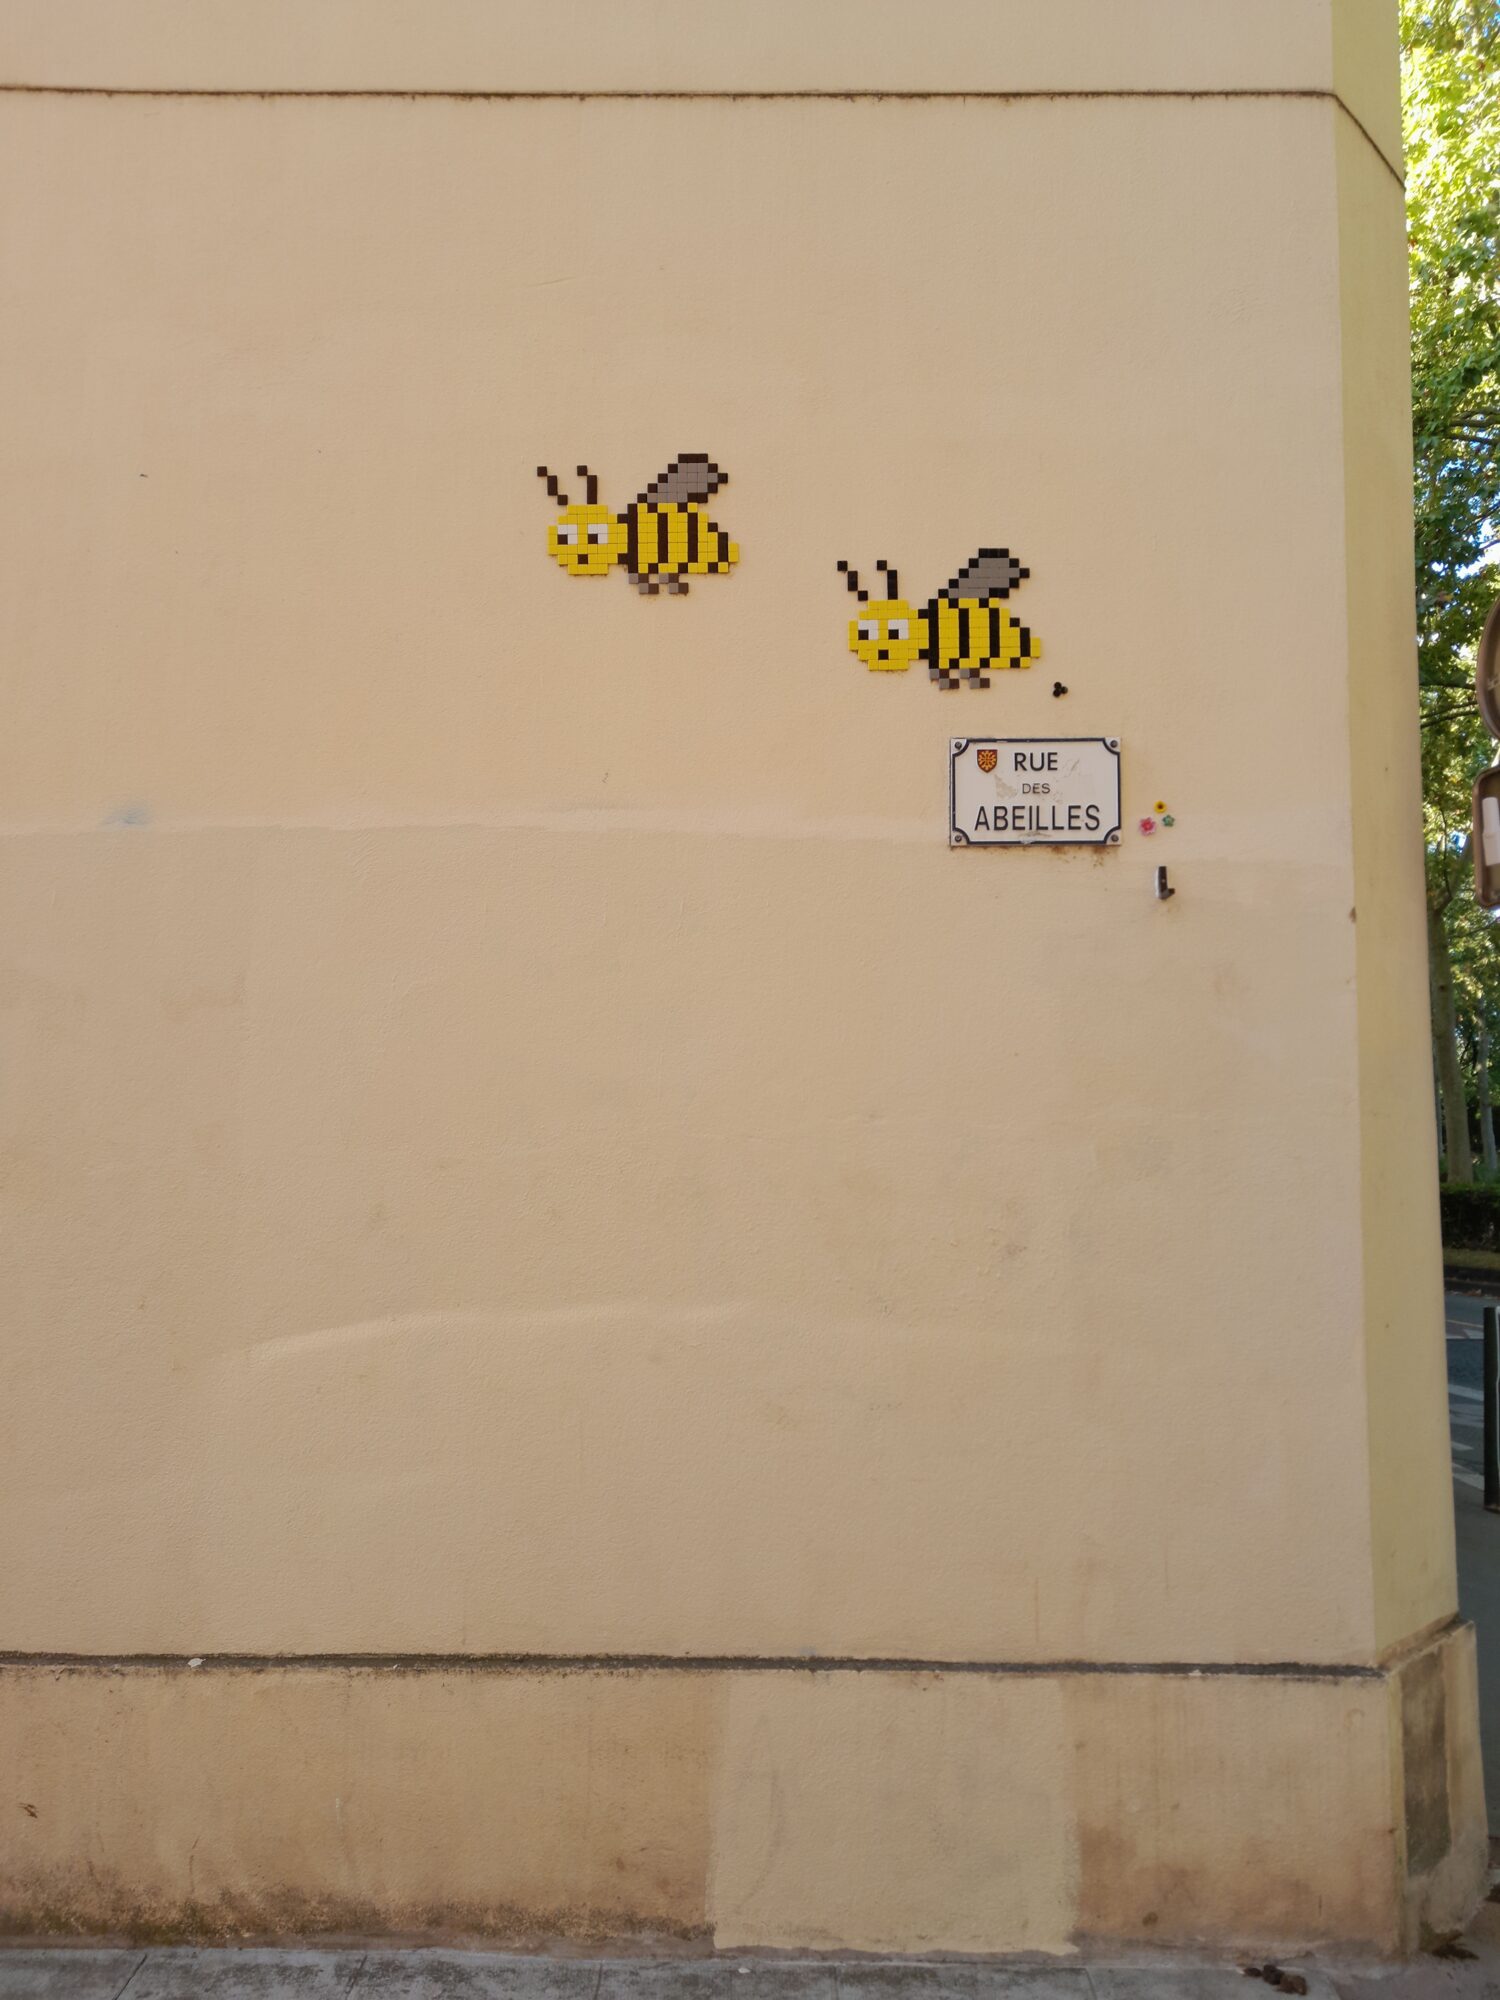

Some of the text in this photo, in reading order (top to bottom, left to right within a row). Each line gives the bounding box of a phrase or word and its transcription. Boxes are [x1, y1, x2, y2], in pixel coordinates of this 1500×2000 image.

[1014, 752, 1058, 772] RUE
[1022, 783, 1051, 794] DES
[974, 804, 1101, 832] ABEILLES
